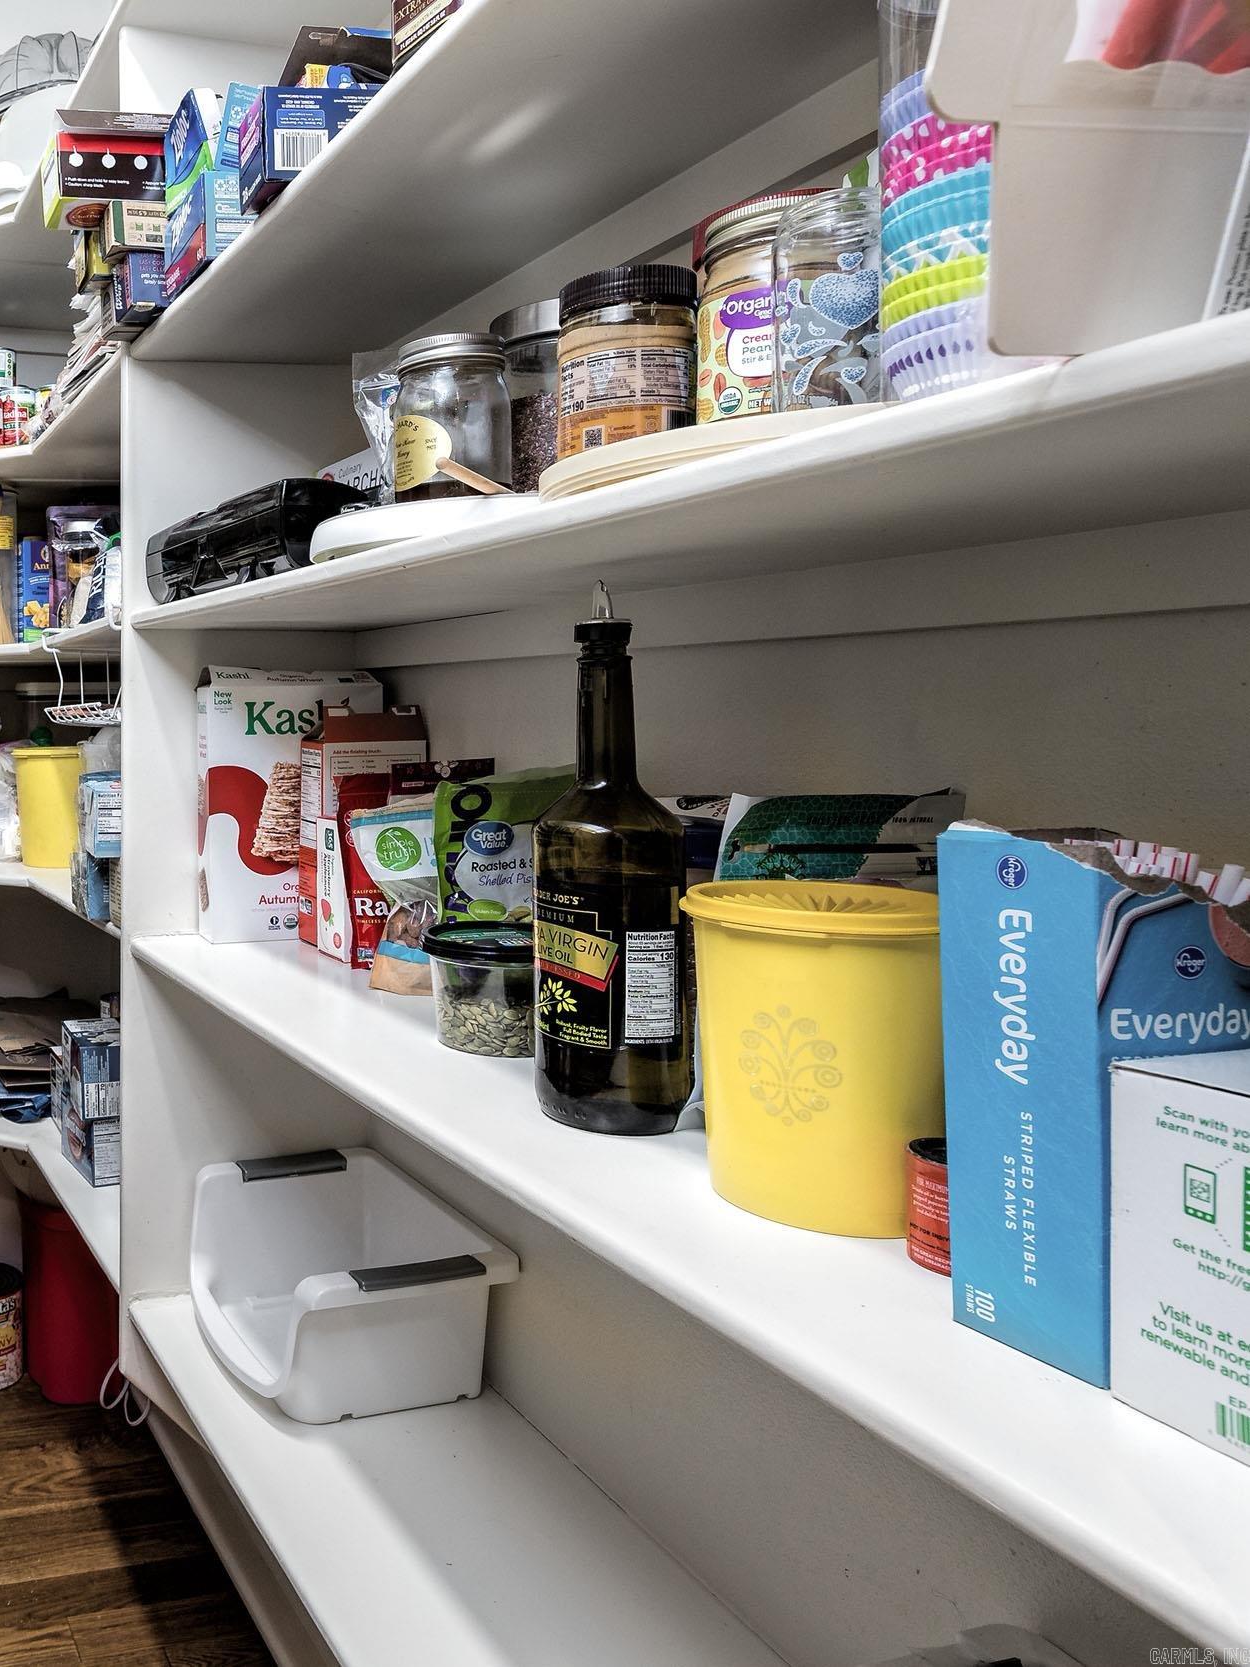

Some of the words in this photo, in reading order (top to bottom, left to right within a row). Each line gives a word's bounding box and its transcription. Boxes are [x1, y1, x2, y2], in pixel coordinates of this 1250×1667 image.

[170, 107, 191, 166] Ziploc
[171, 194, 194, 253] Ziploc
[742, 333, 772, 345] Crea
[742, 345, 772, 356] Pean
[561, 360, 585, 374] Nutrition
[741, 356, 756, 365] Stir
[571, 400, 584, 412] 190
[748, 400, 762, 409] NET
[337, 463, 363, 480] Culinary
[33, 562, 50, 571] Ann
[215, 671, 252, 680] Kashi
[213, 690, 233, 698] New
[244, 698, 324, 736] Kas
[470, 828, 507, 842] Great
[381, 839, 414, 850] simple
[383, 847, 417, 862] truth
[471, 859, 517, 873] Roasted
[518, 859, 528, 869] &
[1005, 856, 1022, 889] Kroger
[478, 874, 514, 887] Shelled
[552, 893, 581, 905] JOE'S
[549, 928, 610, 961] VIRGIN
[627, 932, 659, 942] Nutrition
[659, 933, 675, 942] Facts
[553, 948, 574, 965] OIL
[659, 951, 675, 961] 130
[1174, 952, 1206, 973] Kroger
[992, 907, 1037, 1086] Everyday
[562, 1026, 572, 1035] Full
[572, 1028, 593, 1038] Bodied
[593, 1032, 608, 1040] Taste
[573, 1022, 590, 1032] Fruity
[589, 1026, 608, 1034] Flavor
[558, 1031, 580, 1043] Fragrant
[585, 1037, 608, 1047] Smooth
[1163, 1105, 1196, 1124] Scan
[1198, 1114, 1229, 1132] with
[1232, 1126, 1250, 1140] yo
[1155, 1116, 1190, 1137] learn
[1192, 1130, 1229, 1149] more
[1020, 1111, 1034, 1190] STRIPED
[1003, 1154, 1018, 1231] STRAWS
[1021, 1197, 1037, 1288] FLEXIBLE
[1172, 1237, 1196, 1254] Get
[1199, 1246, 1223, 1266] the
[1226, 1257, 1250, 1277] free
[964, 1283, 975, 1314] STRAWS
[974, 1287, 997, 1323] 100
[1158, 1300, 1193, 1329] Visit
[1195, 1319, 1214, 1337] us
[1216, 1325, 1234, 1345] at
[1151, 1314, 1168, 1332] to
[1170, 1319, 1209, 1353] learn
[1213, 1346, 1250, 1371] more
[1140, 1325, 1217, 1372] renewable
[1219, 1362, 1250, 1388] and
